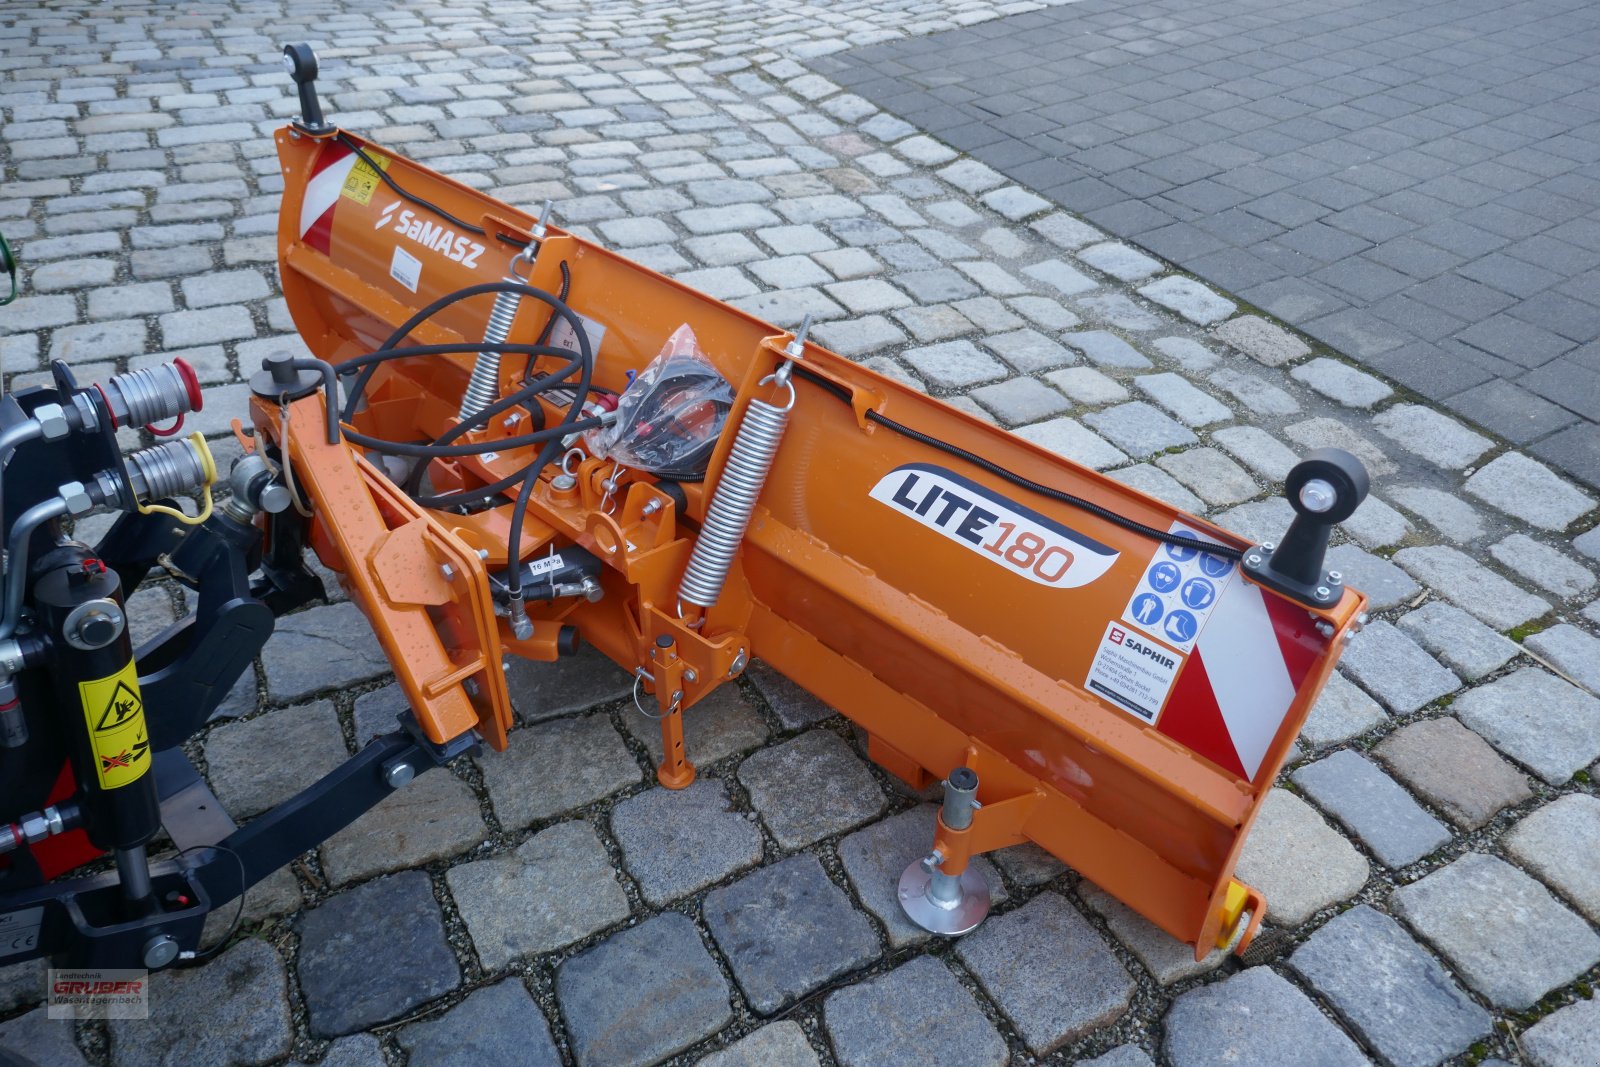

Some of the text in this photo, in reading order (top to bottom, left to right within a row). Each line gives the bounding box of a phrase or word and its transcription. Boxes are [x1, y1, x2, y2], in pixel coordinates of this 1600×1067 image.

[394, 209, 485, 269] SaMASZ
[891, 472, 1075, 583] LITE180
[1102, 646, 1168, 684] Saphir Maschinenbau GmbH
[1125, 638, 1175, 670] SAPHIR
